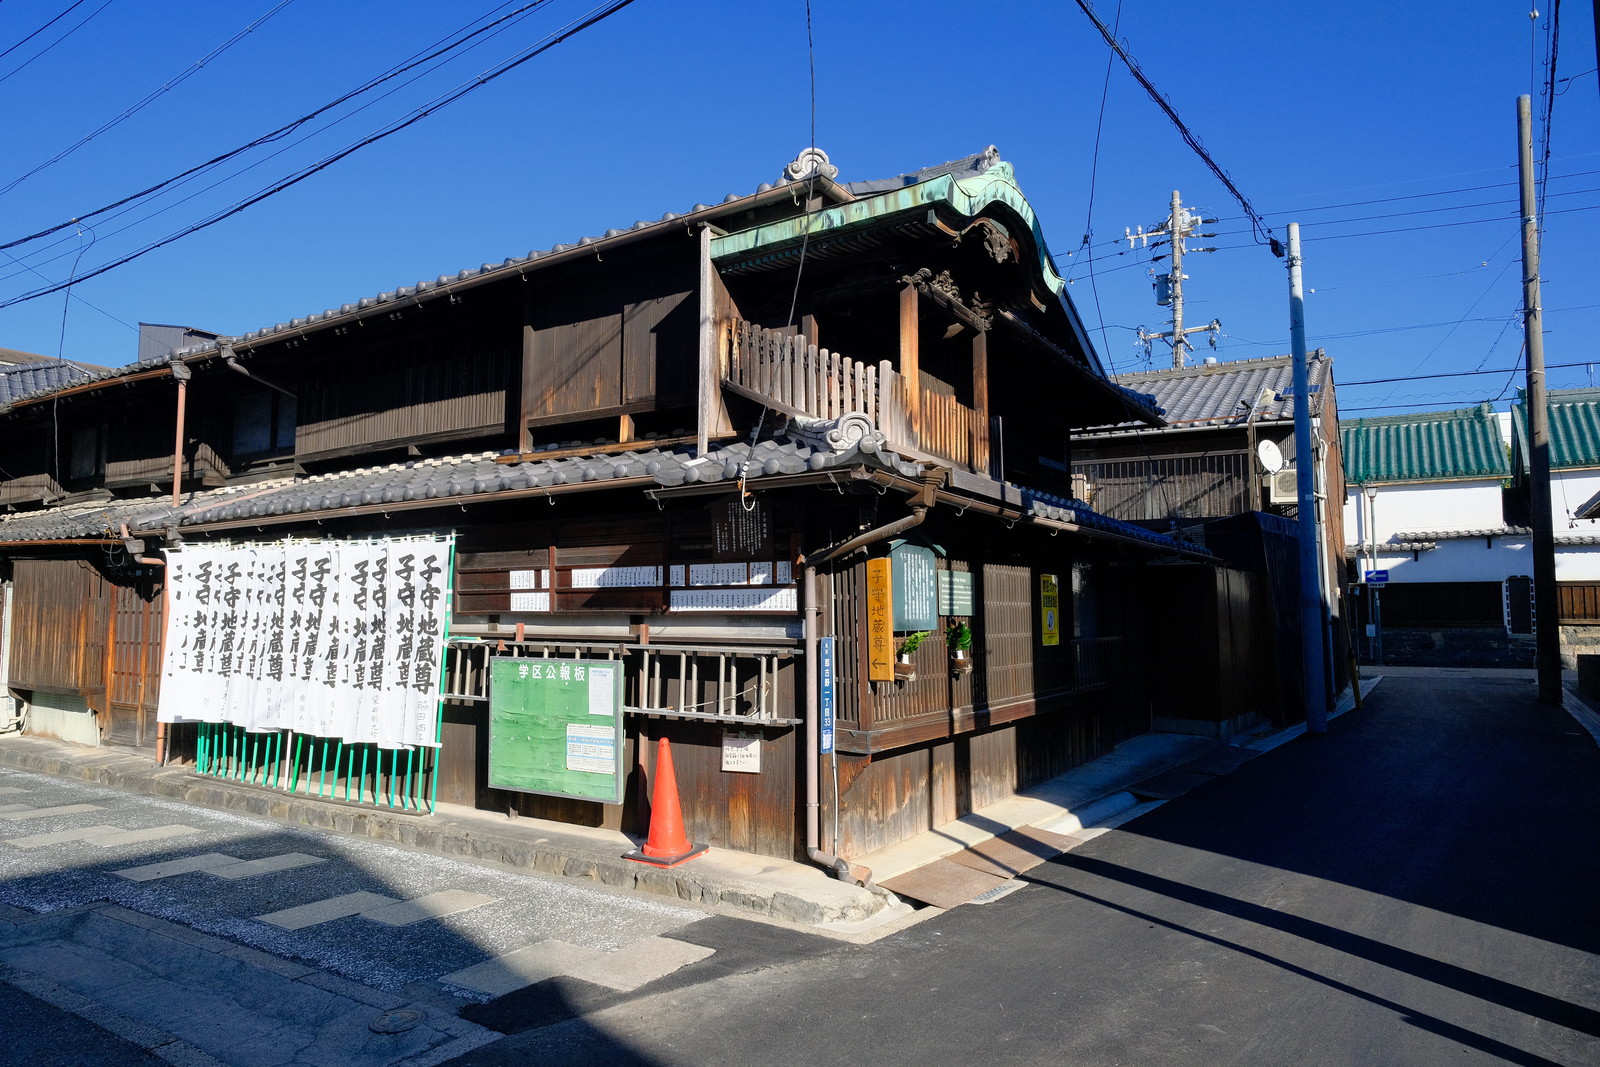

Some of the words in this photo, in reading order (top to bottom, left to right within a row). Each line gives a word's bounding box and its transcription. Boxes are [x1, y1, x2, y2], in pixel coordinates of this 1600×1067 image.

[411, 554, 442, 695] 子守地蔵尊
[871, 569, 886, 652] 子守地蔵尊
[518, 663, 585, 682] 学区公報板
